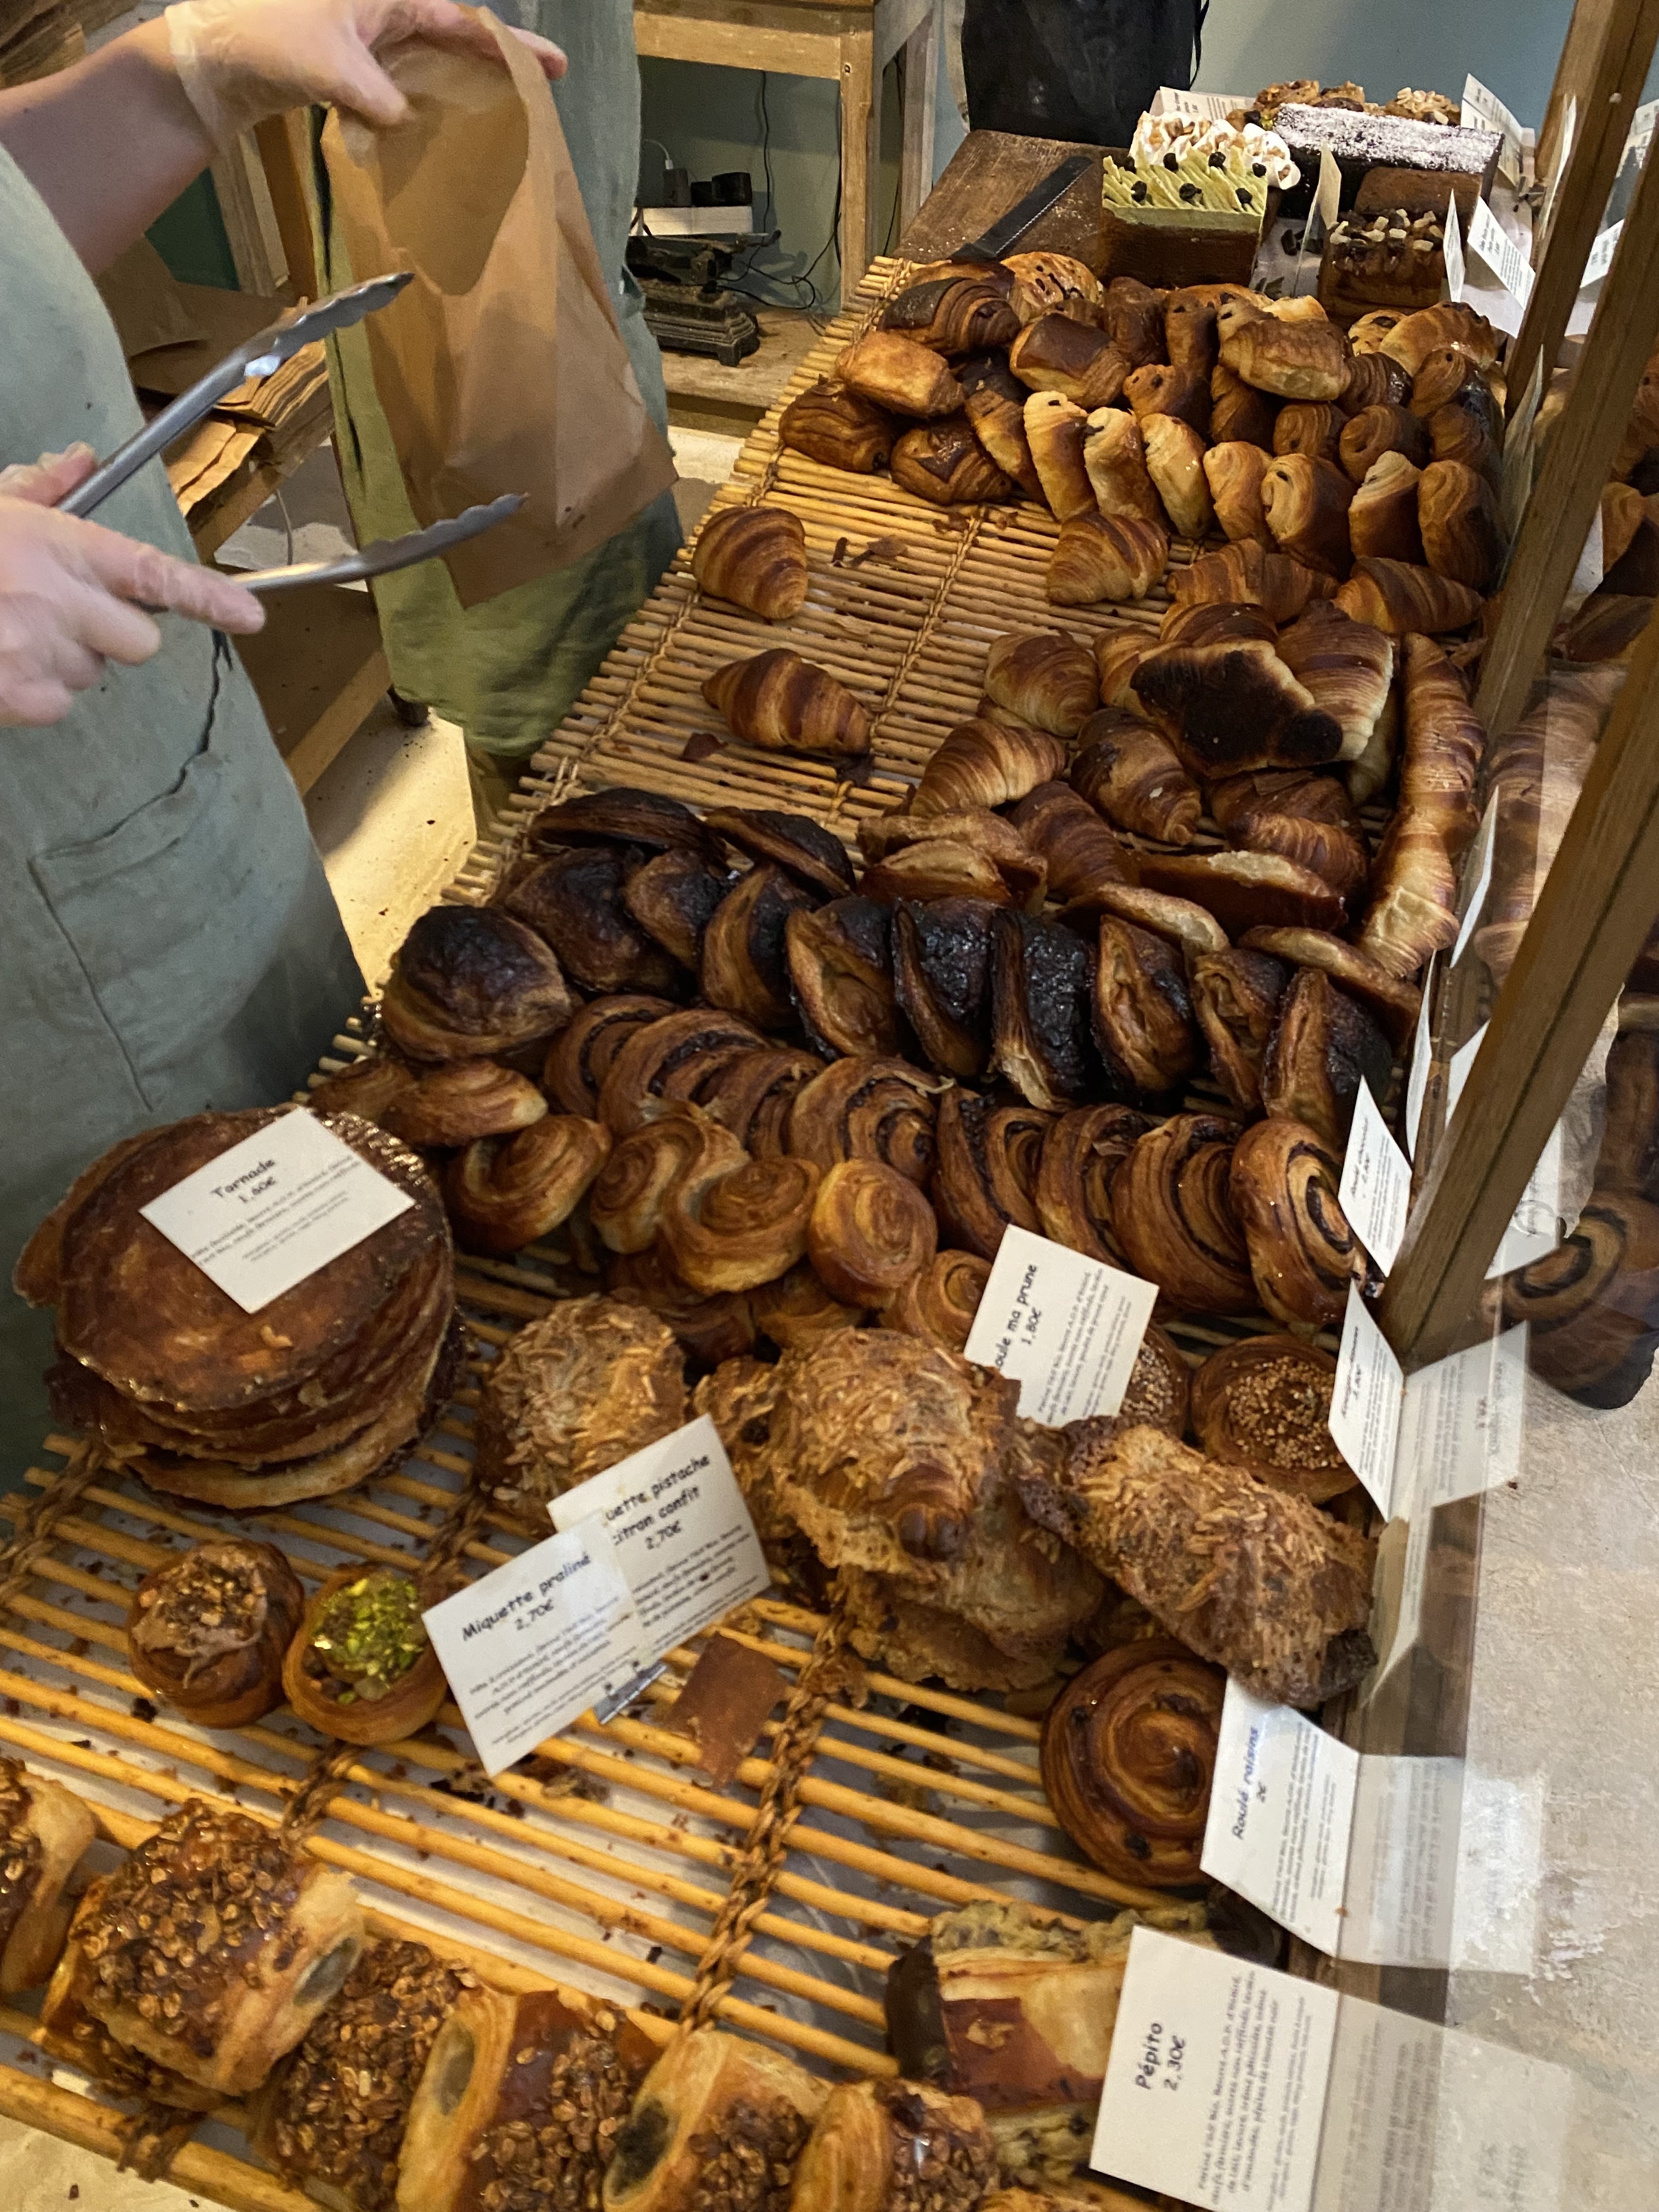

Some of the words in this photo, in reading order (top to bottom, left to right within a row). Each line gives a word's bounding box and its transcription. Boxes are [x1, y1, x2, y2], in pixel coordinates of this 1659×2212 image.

[211, 1159, 276, 1198] Tornade
[995, 1338, 1012, 1369] oule
[1007, 1311, 1021, 1331] ma
[1016, 1265, 1037, 1306] prune
[651, 1455, 711, 1499] pistache
[658, 1486, 699, 1519] confit
[646, 1520, 682, 1550] 2,70€
[462, 1592, 534, 1641] Miquette
[538, 1551, 591, 1596] praliné
[515, 1599, 555, 1631] 2,70€
[1232, 1790, 1249, 1840] Roulé
[1243, 1726, 1260, 1785] raisins
[1135, 2023, 1163, 2090] Pépito
[1164, 2035, 1186, 2091] 2,30€
